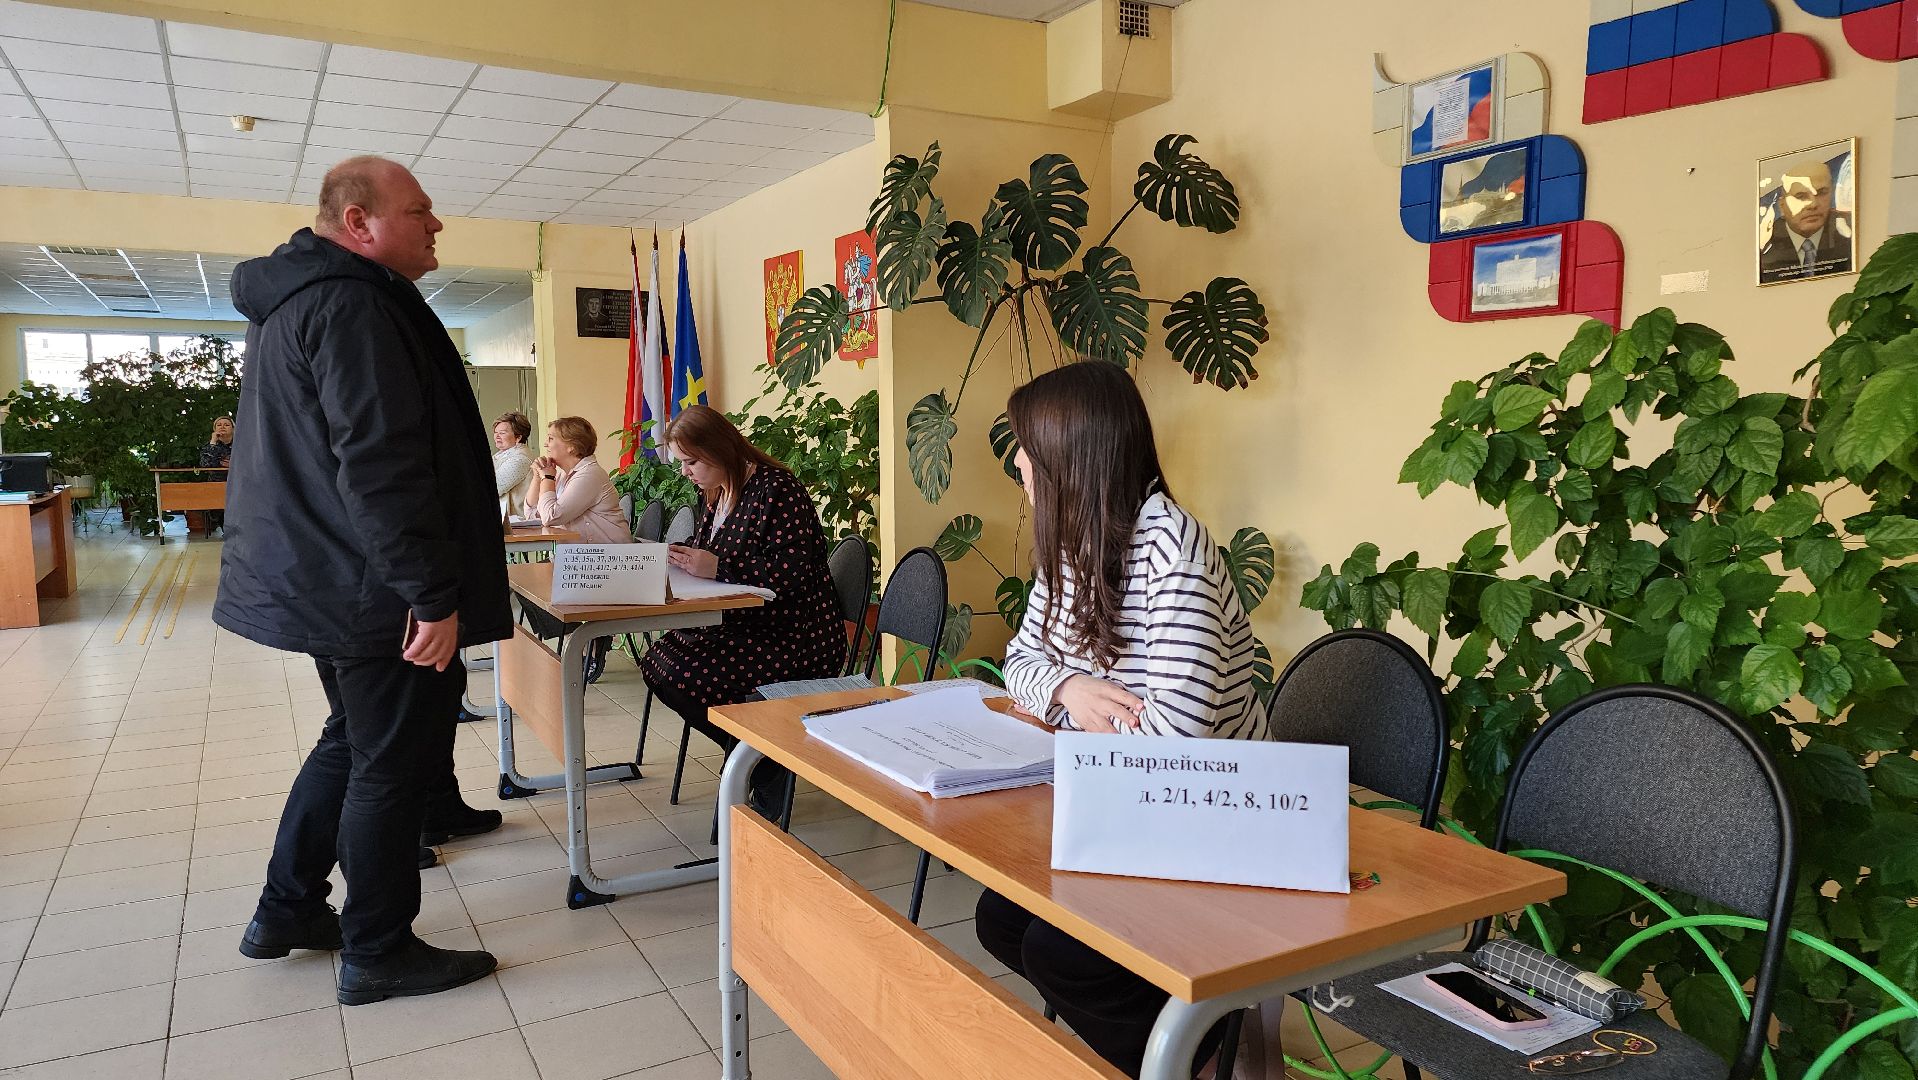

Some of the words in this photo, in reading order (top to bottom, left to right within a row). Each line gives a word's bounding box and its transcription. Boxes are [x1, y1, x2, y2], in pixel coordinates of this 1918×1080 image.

[562, 573, 579, 581] СНТ
[1074, 753, 1102, 770] ул.
[1109, 751, 1239, 774] Гвардейская
[1138, 789, 1156, 804] д.
[1163, 787, 1196, 808] 2/1,
[1203, 789, 1237, 810] 4/2,
[1244, 791, 1261, 811] 8,
[1268, 793, 1309, 811] 10/2
